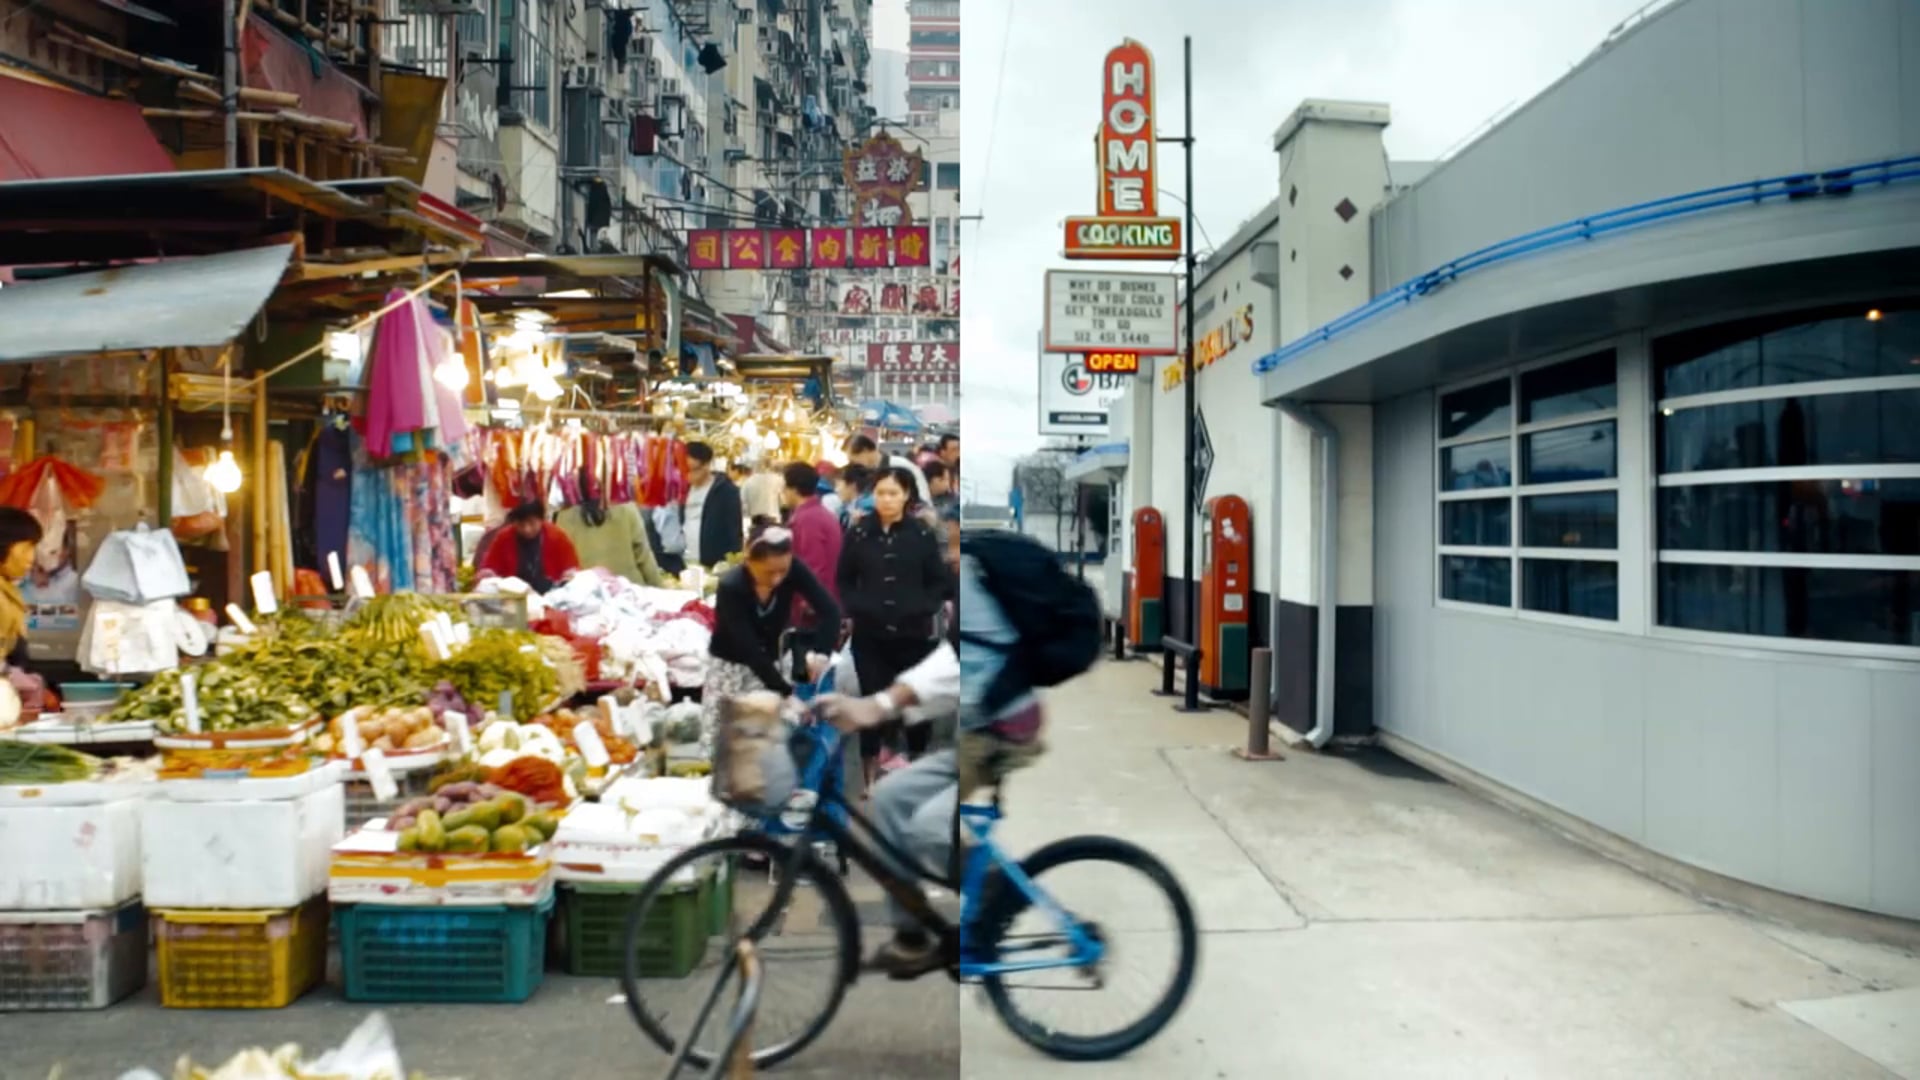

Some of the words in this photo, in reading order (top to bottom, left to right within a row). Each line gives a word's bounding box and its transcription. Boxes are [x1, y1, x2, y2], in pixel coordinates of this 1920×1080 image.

[1107, 62, 1149, 211] HOME
[1076, 223, 1174, 246] COOKING
[1069, 280, 1092, 291] WHY
[1097, 281, 1112, 291] DO
[1120, 281, 1156, 292] DISHES
[1071, 292, 1099, 303] WHEN
[1105, 293, 1126, 304] YOU
[1131, 294, 1165, 305] COULD
[1065, 306, 1084, 316] GET
[1091, 306, 1162, 318] THREADGILLS
[1092, 319, 1105, 329] TO
[1117, 319, 1131, 330] GO
[1074, 331, 1091, 341] 512
[1099, 332, 1116, 343] 451
[1121, 333, 1150, 344] 5440
[1089, 353, 1136, 371] OPEN
